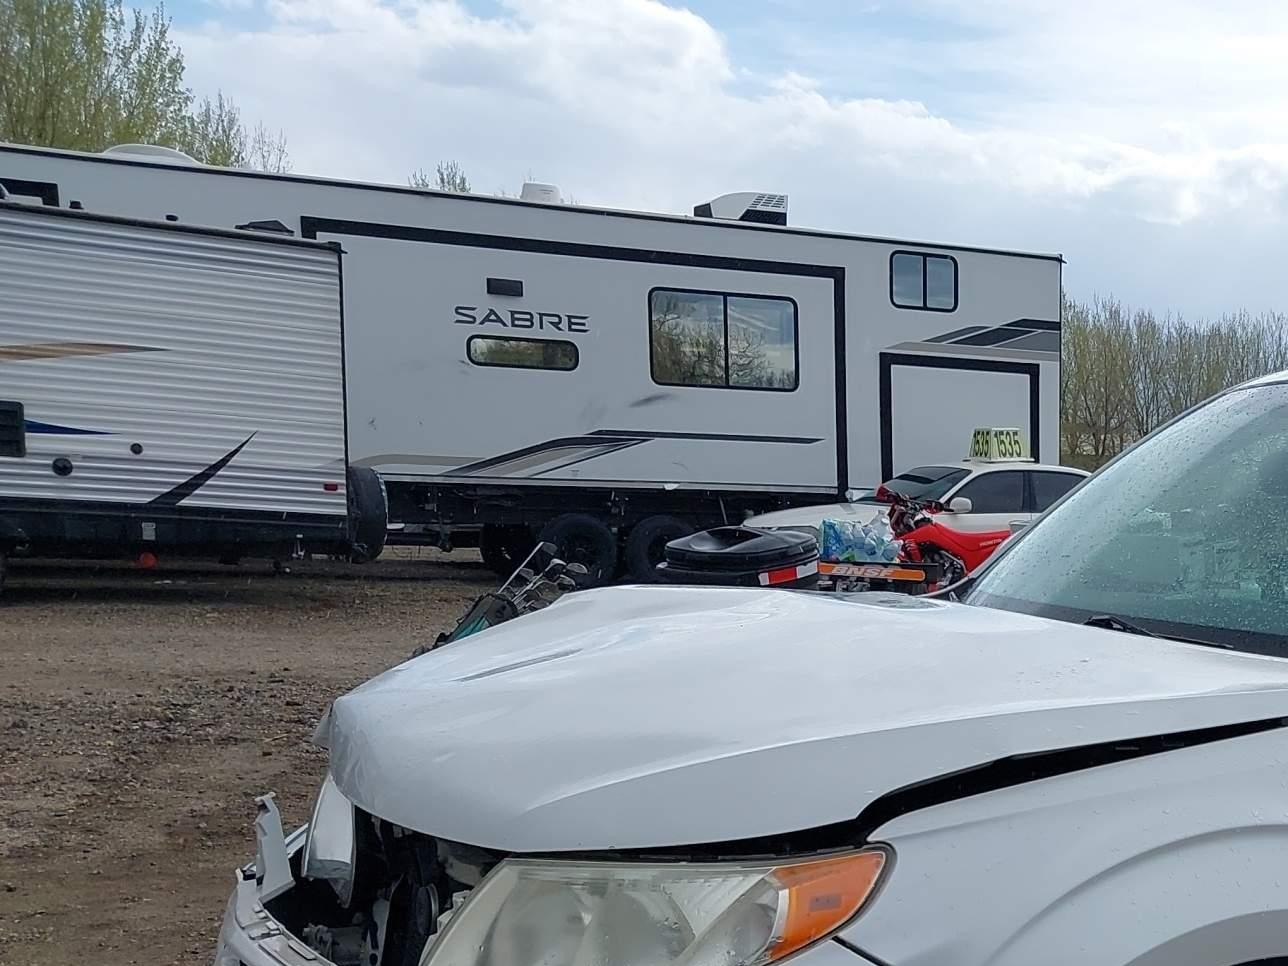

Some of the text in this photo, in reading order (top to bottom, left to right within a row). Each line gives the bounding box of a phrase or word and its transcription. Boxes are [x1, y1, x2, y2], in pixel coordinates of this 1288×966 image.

[454, 306, 590, 333] SABRE
[993, 429, 1022, 458] 1535
[830, 564, 896, 578] BNSF
